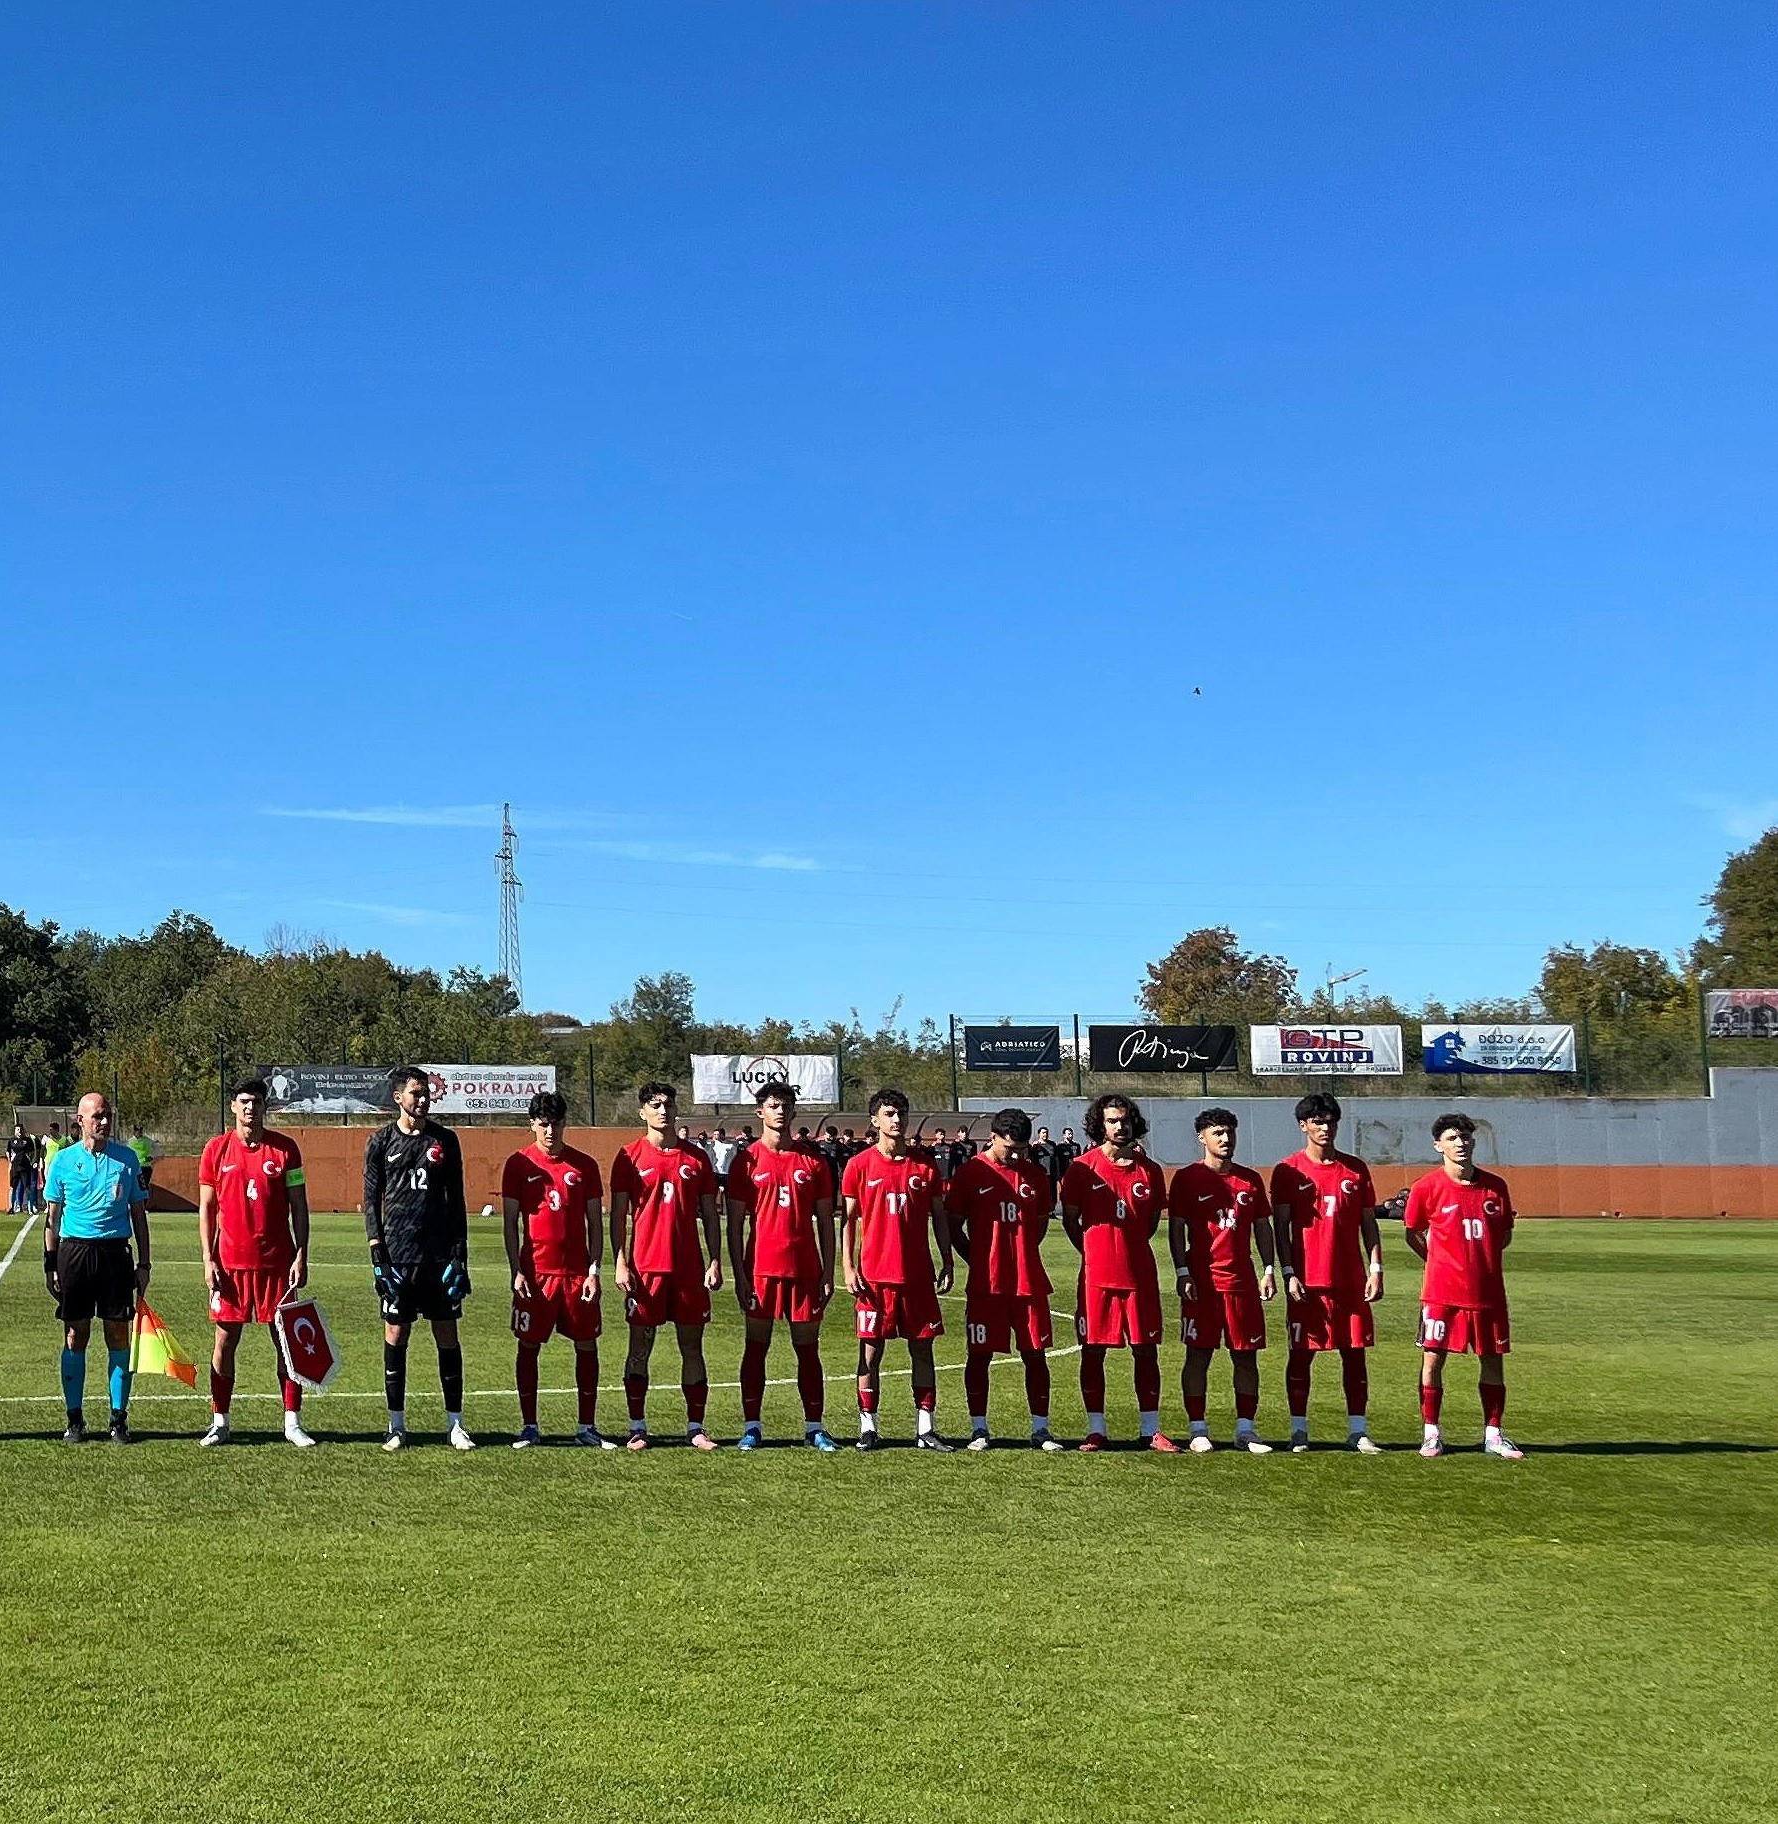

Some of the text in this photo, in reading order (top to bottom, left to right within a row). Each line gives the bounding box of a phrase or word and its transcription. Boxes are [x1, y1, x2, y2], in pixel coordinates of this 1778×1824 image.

[1286, 1029, 1364, 1047] GTP
[1287, 1051, 1368, 1062] ROVINJ
[732, 1071, 790, 1084] LUCKY
[246, 1178, 258, 1201] 4
[408, 1167, 428, 1190] 12
[663, 1181, 675, 1204] 9
[778, 1185, 791, 1208] 5
[886, 1192, 908, 1215] 17
[999, 1201, 1017, 1222] 18
[1116, 1198, 1127, 1220] 8
[1323, 1195, 1337, 1217] 7
[1462, 1218, 1483, 1241] 10
[628, 1298, 638, 1317] 9
[514, 1309, 531, 1332] 13
[858, 1310, 878, 1333] 17
[1182, 1316, 1198, 1343] 14
[1424, 1318, 1446, 1341] 10
[968, 1323, 987, 1344] 18
[1291, 1322, 1302, 1343] 7
